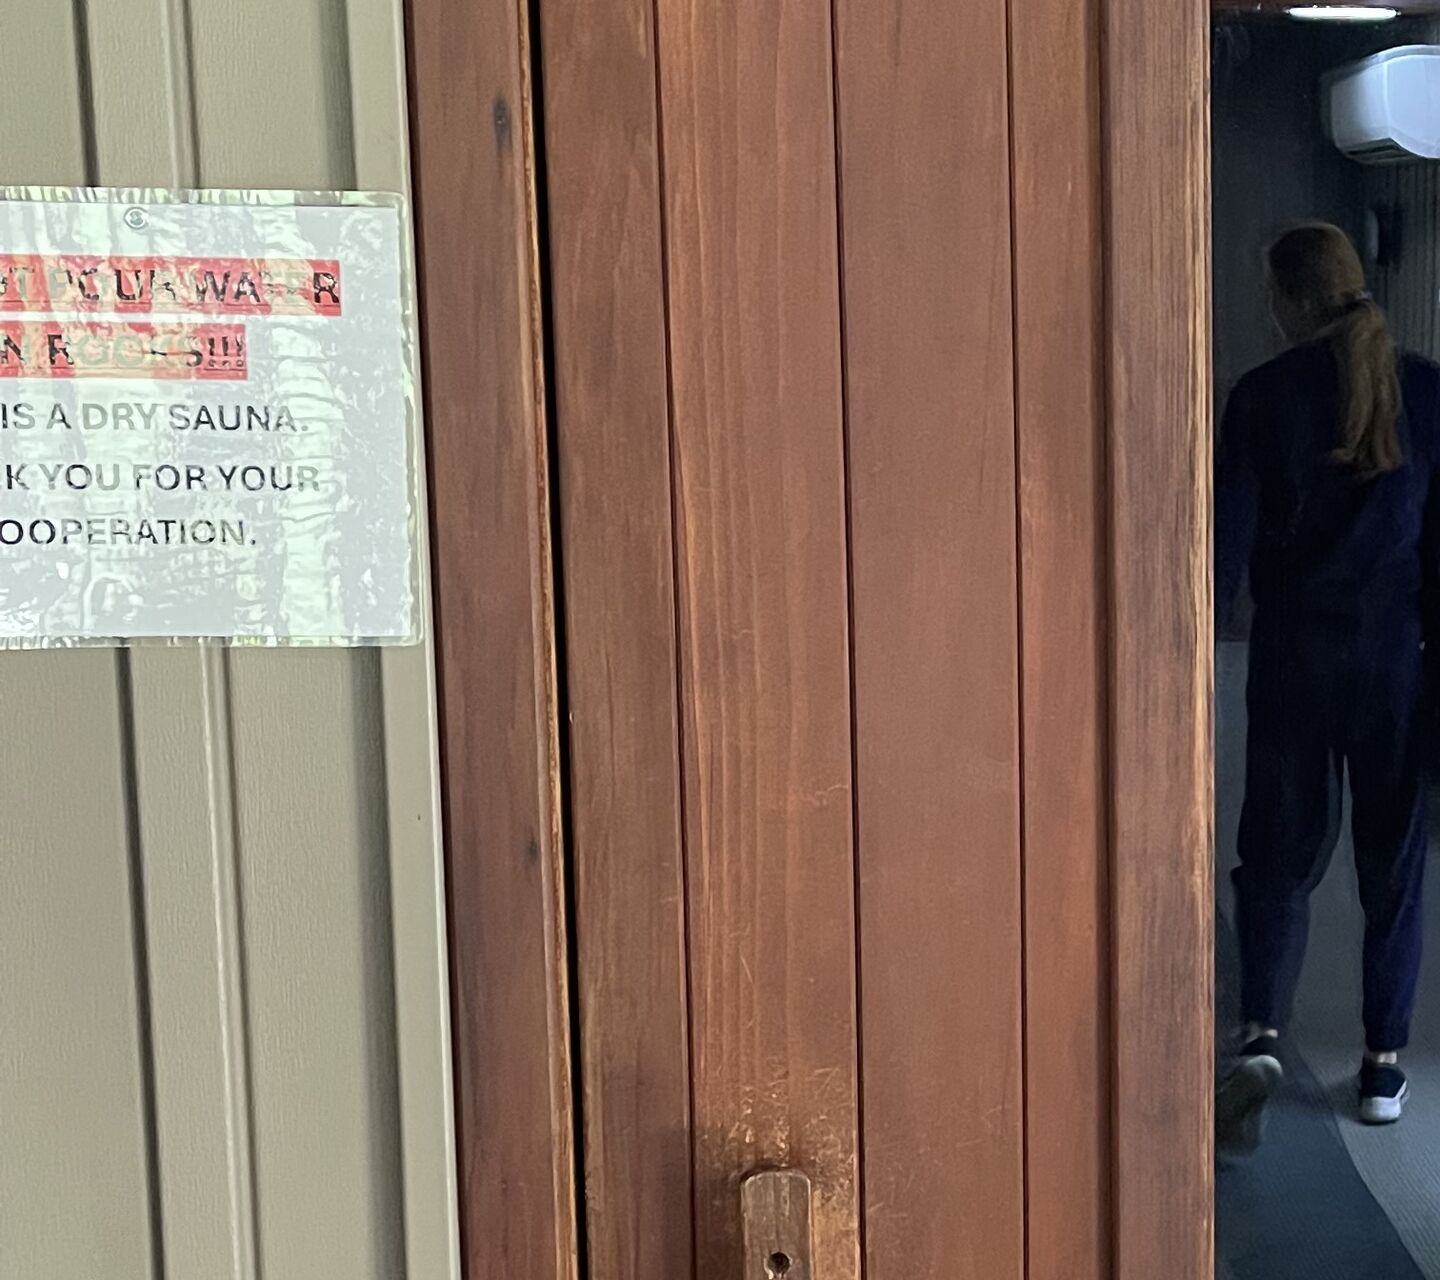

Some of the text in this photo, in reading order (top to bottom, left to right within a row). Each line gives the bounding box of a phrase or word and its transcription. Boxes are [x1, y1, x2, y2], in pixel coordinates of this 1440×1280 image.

[46, 403, 72, 430] A
[82, 403, 157, 431] DRY
[168, 404, 309, 433] SAUNA.
[38, 464, 120, 491] YOU
[132, 464, 207, 491] FOR
[216, 465, 320, 492] YOUR
